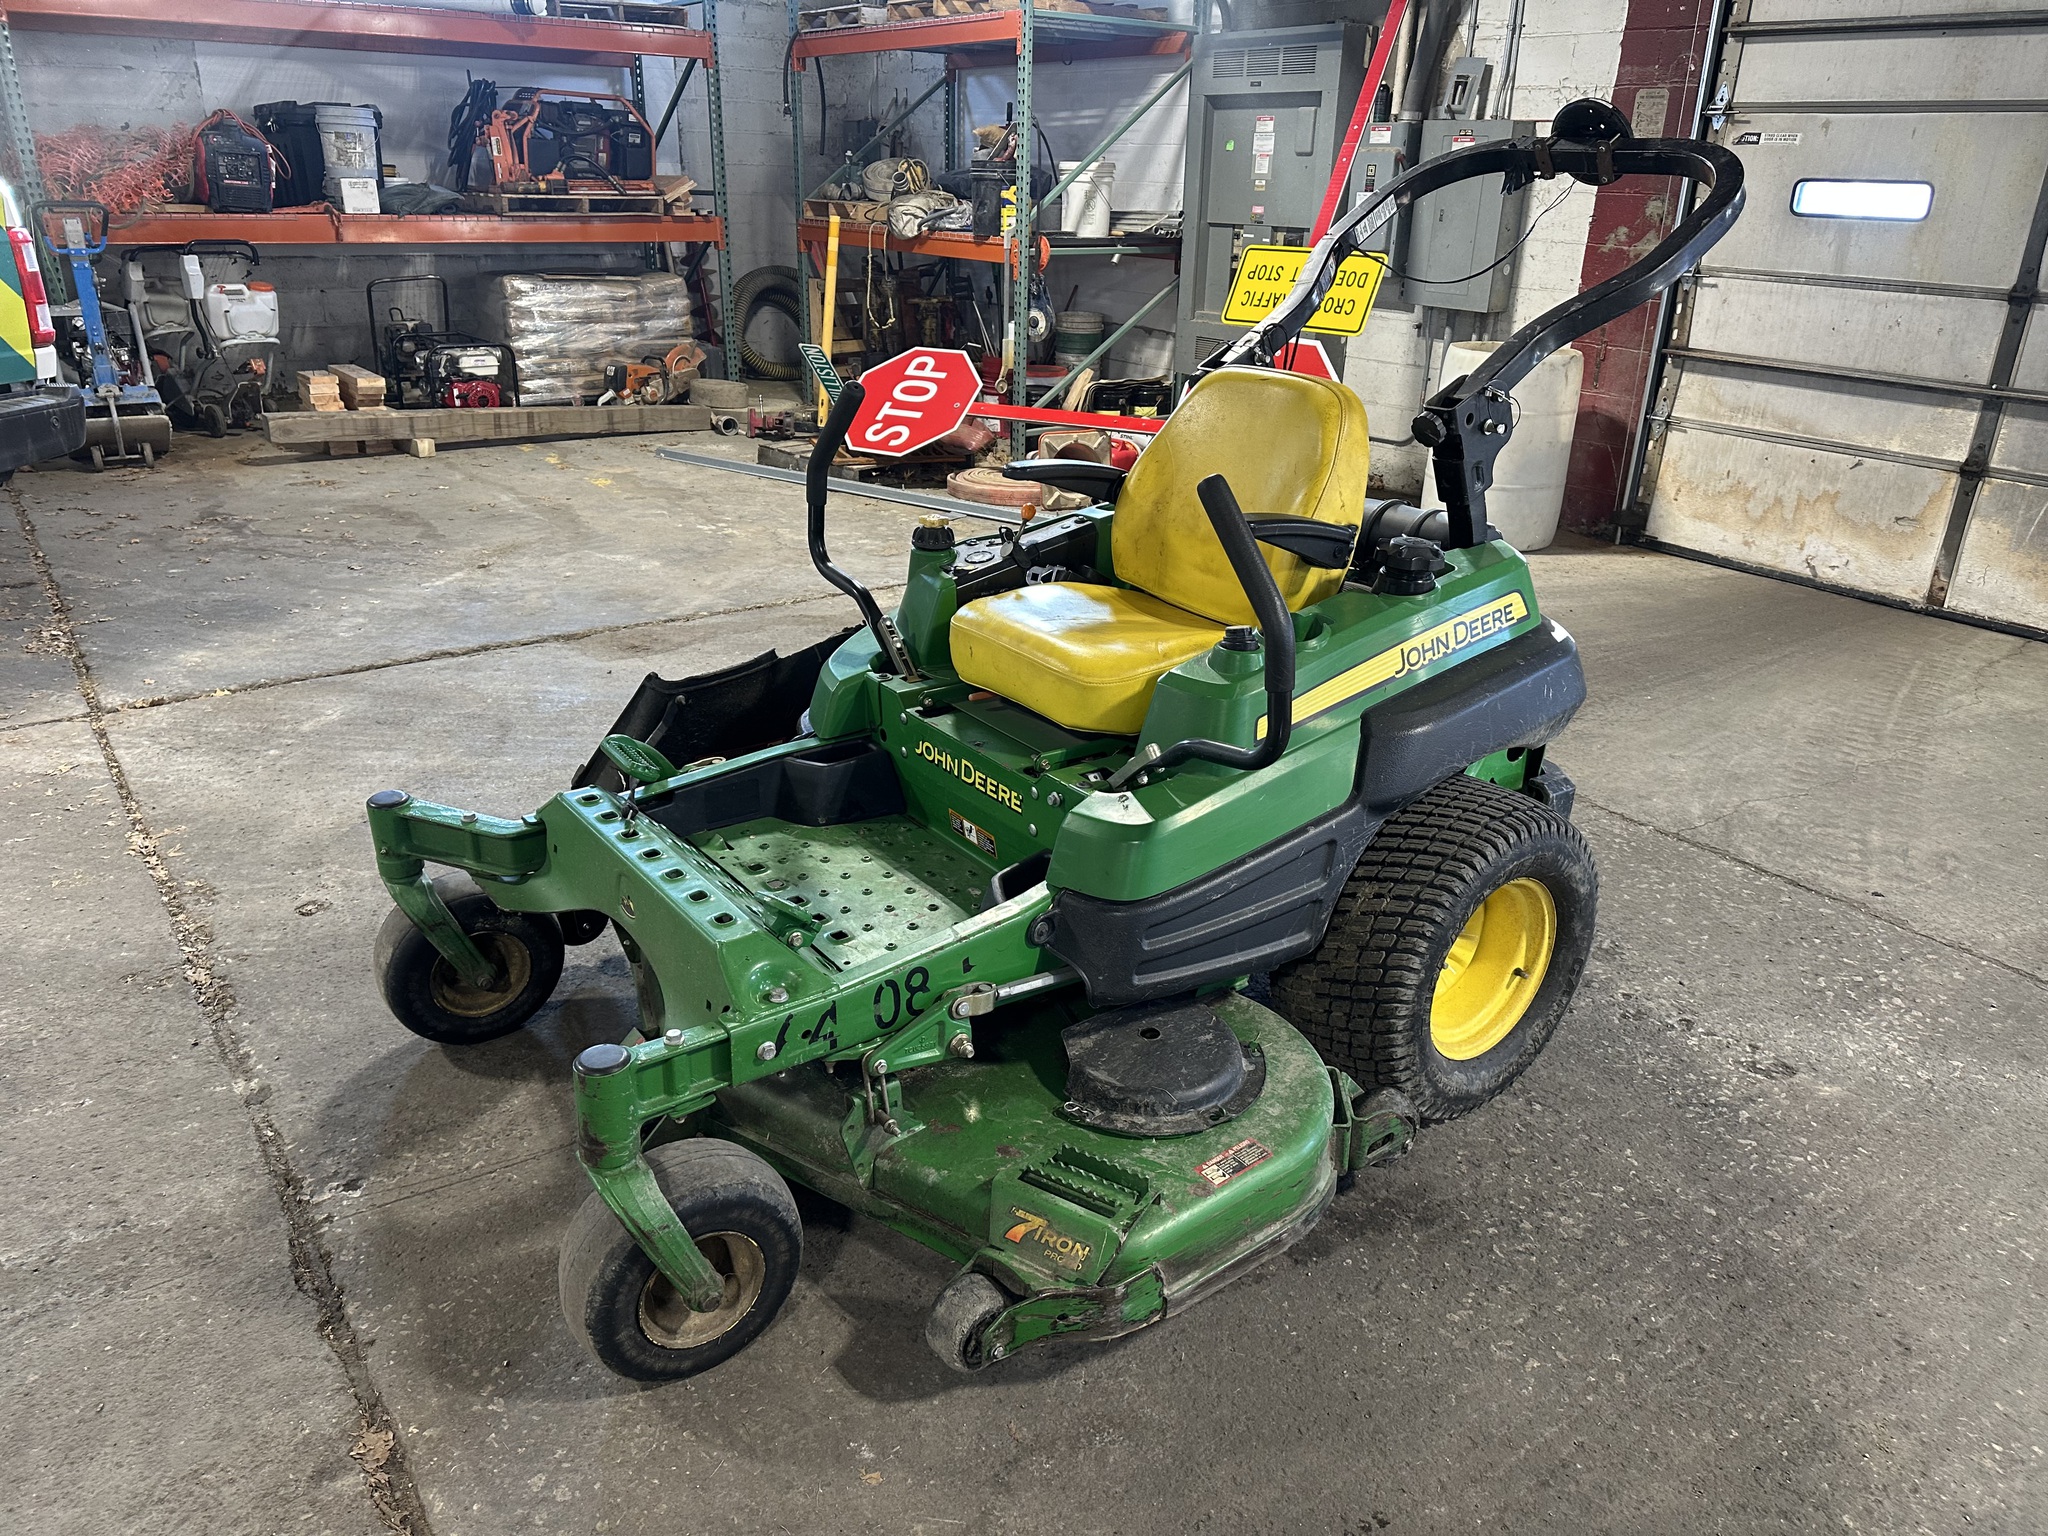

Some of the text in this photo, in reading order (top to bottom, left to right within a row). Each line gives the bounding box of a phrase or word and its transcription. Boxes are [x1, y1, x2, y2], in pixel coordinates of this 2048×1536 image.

[1241, 290, 1356, 316] CRO AFFIC
[1247, 264, 1284, 282] STOP
[1335, 270, 1370, 289] DOE
[864, 355, 948, 447] STOP
[1395, 602, 1516, 676] JOHN DEERE
[914, 740, 1023, 813] JOHN DEERE
[873, 966, 931, 1030] 08
